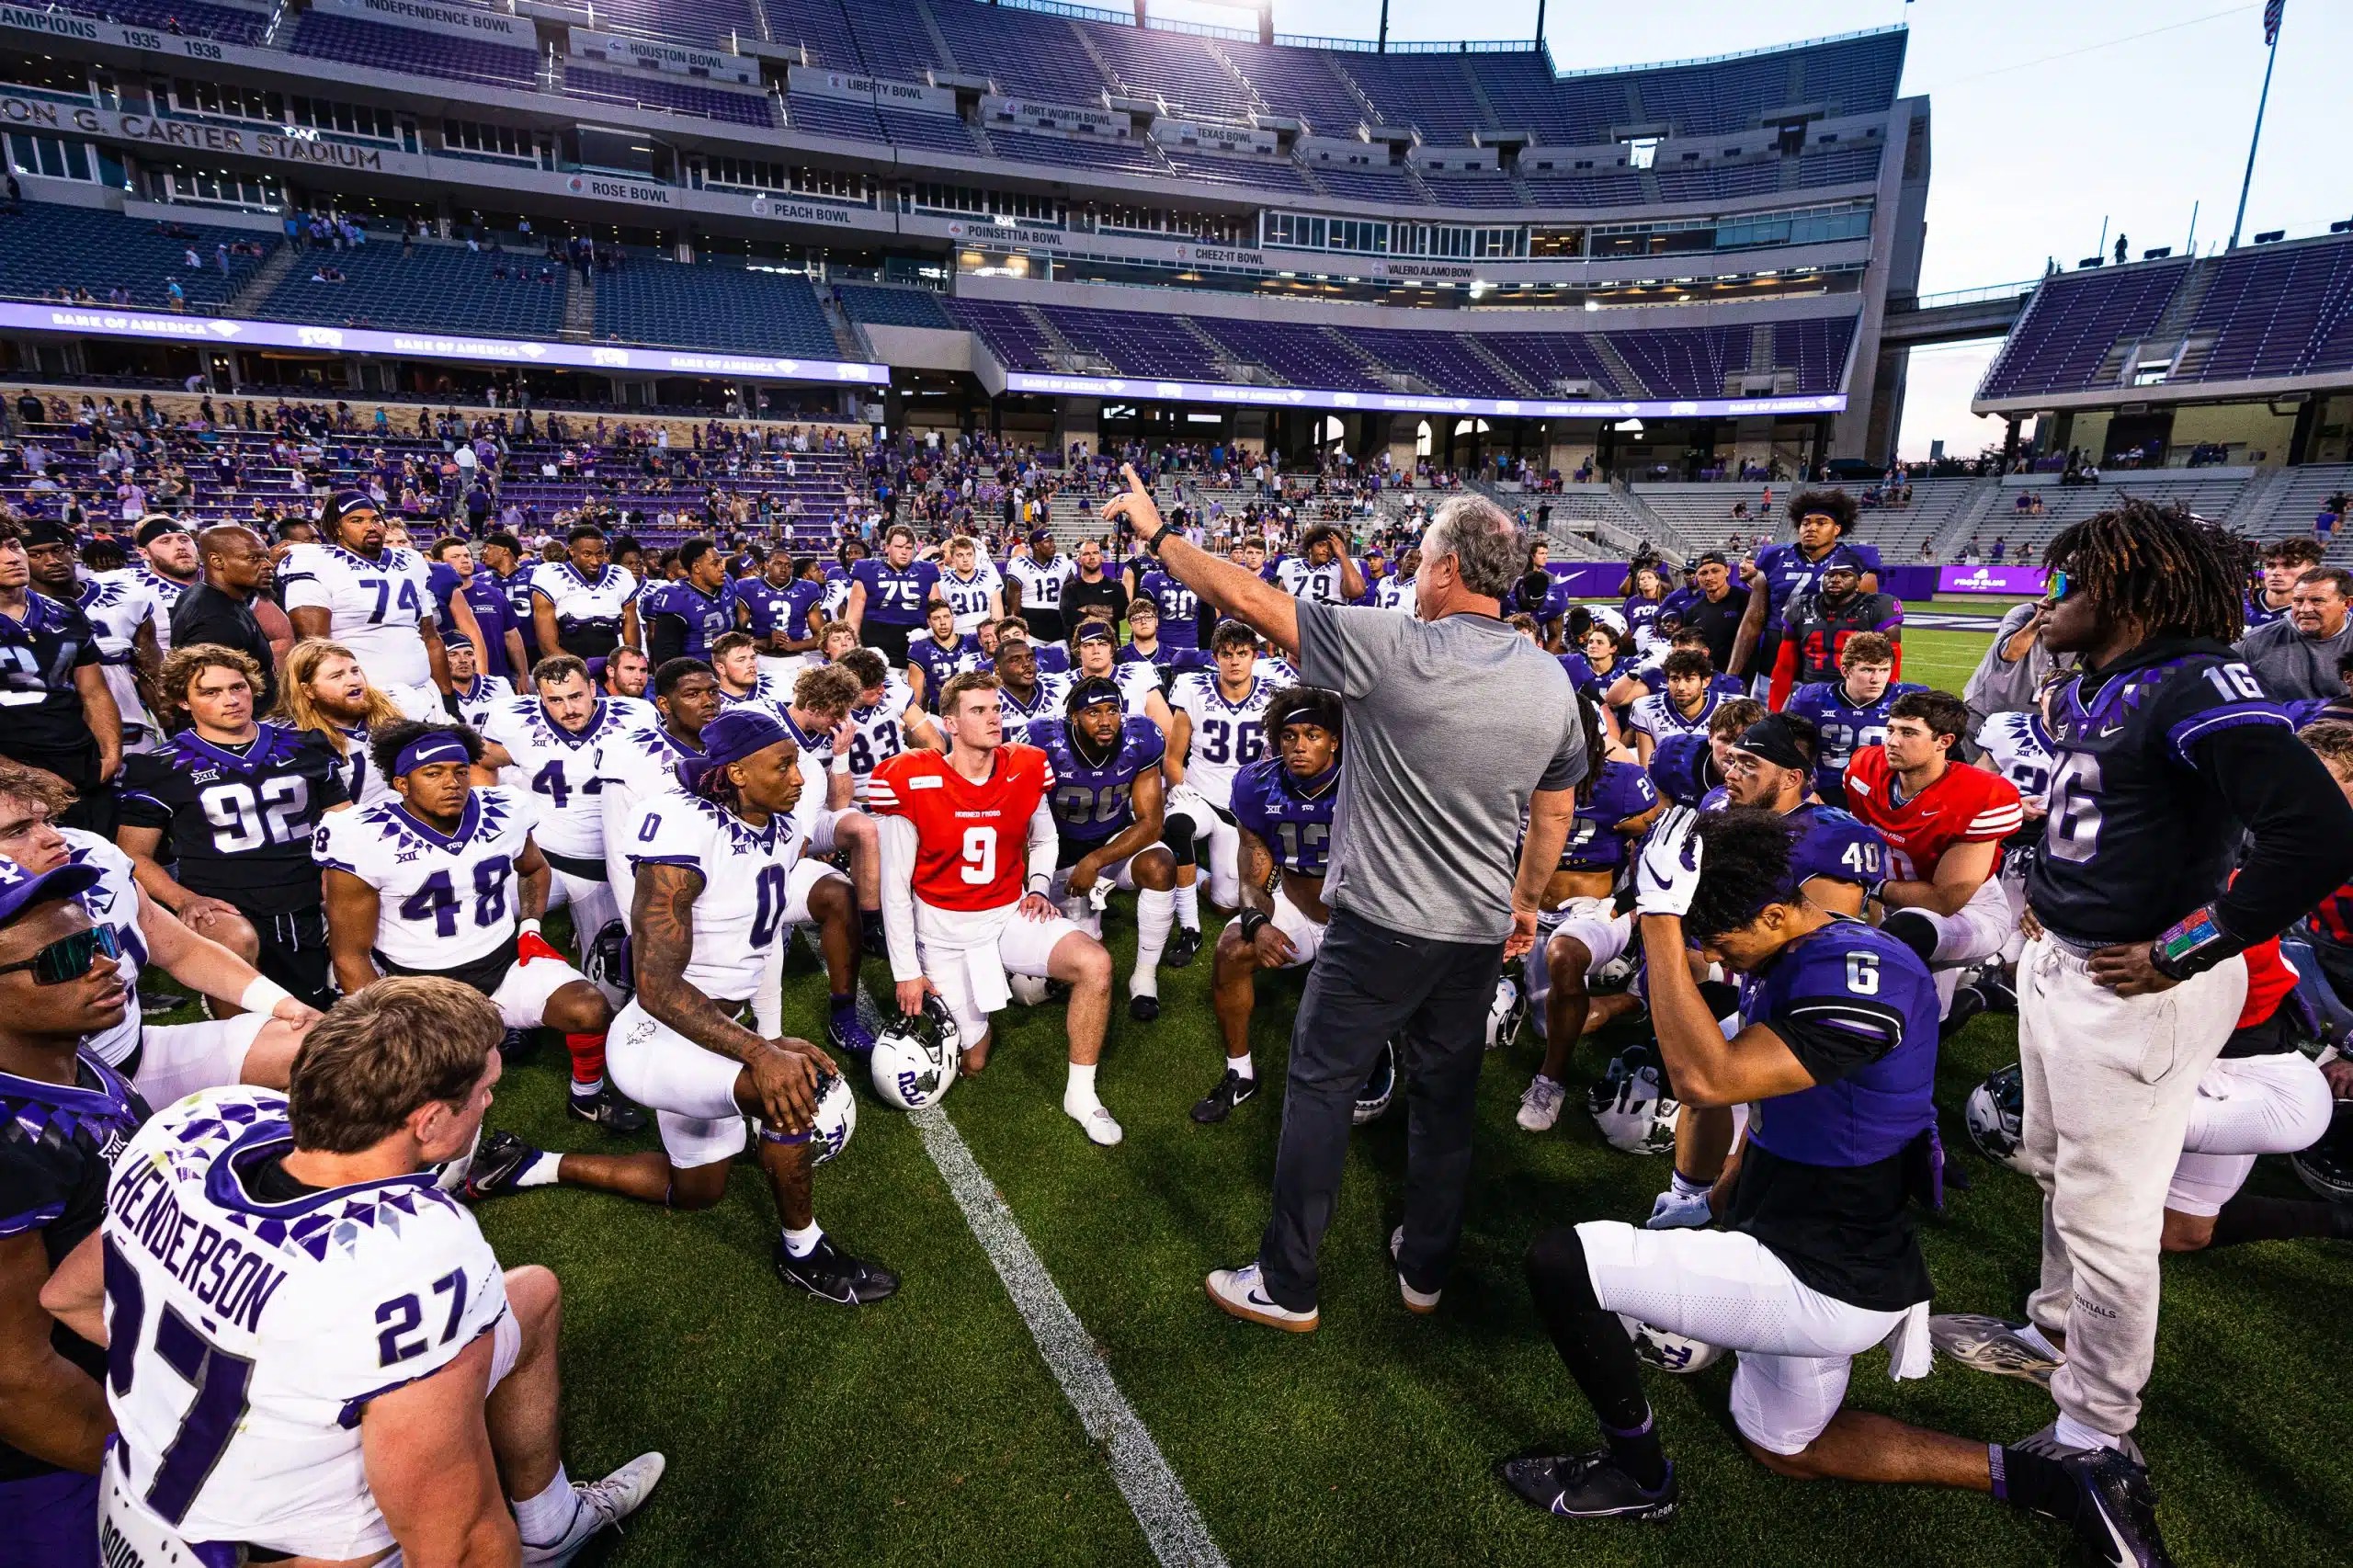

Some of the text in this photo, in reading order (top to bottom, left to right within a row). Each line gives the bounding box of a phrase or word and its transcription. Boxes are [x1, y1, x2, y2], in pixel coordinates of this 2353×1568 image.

[367, 0, 514, 34] INDEPENDENCE BOWL
[2, 9, 222, 60] AMPIONS 1935 1938
[630, 42, 724, 70] HOUSTON BOWL
[847, 78, 924, 100] LIBERTY BOWL
[1022, 103, 1112, 127] FORT WORTH BOWL
[1, 97, 382, 171] ON G. CARTER STADIUM
[1197, 127, 1252, 144] TEXAS BOWL
[592, 182, 670, 204] ROSE BOWL
[774, 203, 851, 223] PEACH BOWL
[967, 223, 1063, 245] POINSETTIA BOWL
[1195, 247, 1265, 265] CHEEZ-IT BOWL
[1388, 264, 1418, 276] VALERO
[1419, 265, 1451, 277] ALAMO
[51, 312, 208, 335] BANK OF AMERICA
[393, 338, 519, 357] BANK OF AMERICA
[878, 580, 920, 610] 75
[1036, 577, 1058, 603] 12
[1293, 574, 1331, 600] 79
[358, 578, 422, 625] 74
[654, 593, 669, 608] 21
[951, 590, 988, 616] 30
[1160, 589, 1199, 620] 30
[768, 600, 791, 632] 3
[2202, 663, 2265, 702] 16
[1821, 710, 1836, 718] XII
[354, 731, 367, 739] TCU
[532, 739, 548, 747] XII
[848, 719, 902, 775] 83
[1202, 718, 1265, 767] 36
[2015, 749, 2031, 757] XII
[661, 766, 676, 775] XI
[1058, 771, 1074, 779] XII
[1636, 776, 1656, 802] 2
[199, 775, 313, 854] 92
[1265, 804, 1282, 814] XII
[311, 826, 331, 853] 8
[638, 812, 663, 843] 0
[394, 849, 420, 864] XII
[447, 842, 463, 852] TCU
[731, 843, 749, 856] XII
[961, 825, 997, 885] 9
[1277, 823, 1330, 878] 13
[1841, 842, 1880, 873] 40
[399, 854, 514, 938] 48
[749, 862, 787, 950] 0
[1846, 950, 1880, 995] 6
[109, 1153, 288, 1335] HENDERSON
[375, 1267, 466, 1369] 27
